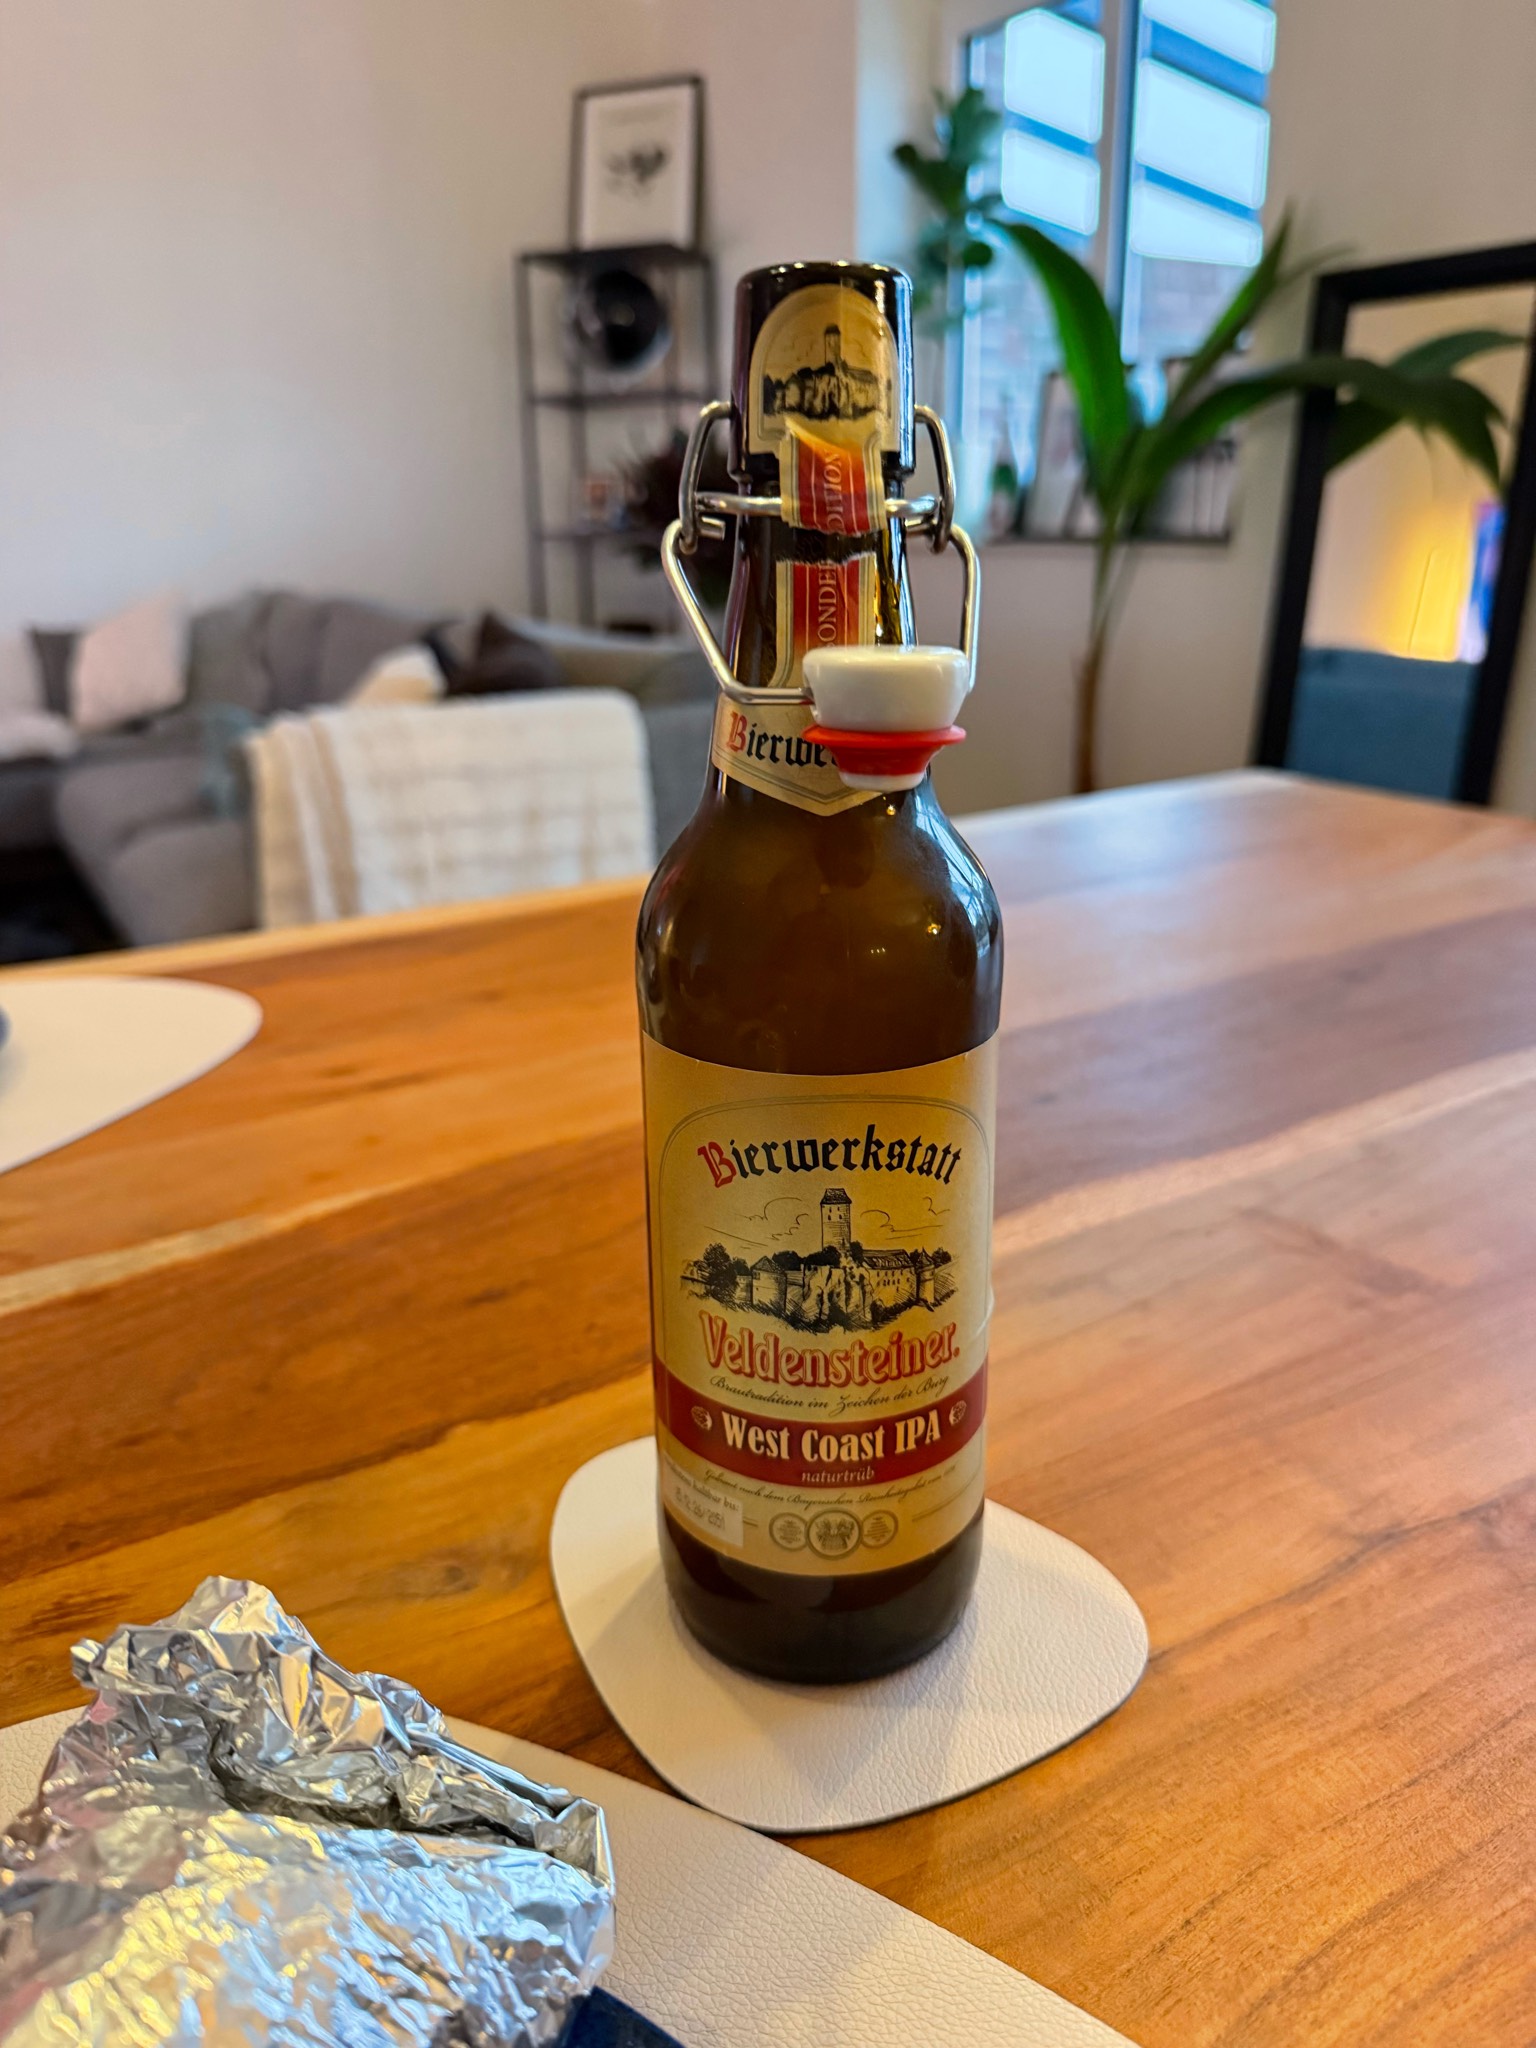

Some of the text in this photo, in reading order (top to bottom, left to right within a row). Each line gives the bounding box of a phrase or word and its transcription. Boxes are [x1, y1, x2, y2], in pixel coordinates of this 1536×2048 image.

[818, 559, 837, 648] ONDE
[726, 711, 838, 767] Bierwe
[697, 1124, 962, 1188] Bierwerkstatt
[710, 1374, 949, 1417] Brautradition im Zeichen der Burg
[721, 1409, 941, 1462] West Coast IPA
[801, 1465, 875, 1483] naturtrüb
